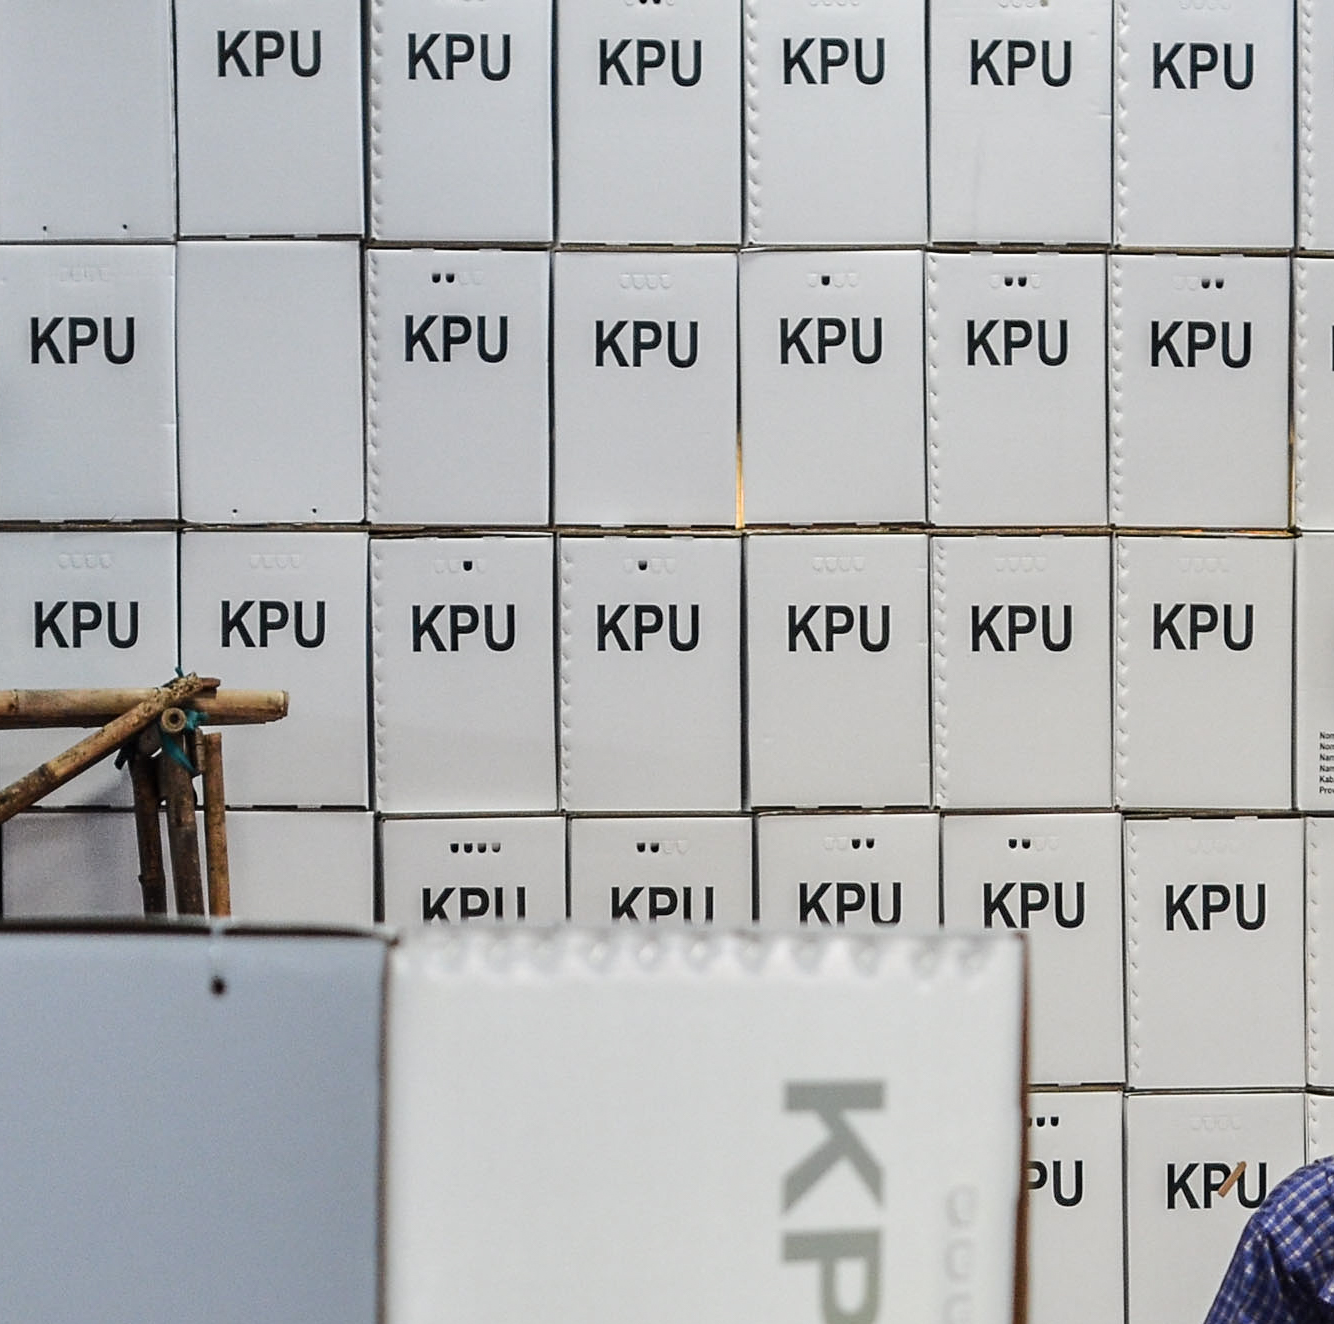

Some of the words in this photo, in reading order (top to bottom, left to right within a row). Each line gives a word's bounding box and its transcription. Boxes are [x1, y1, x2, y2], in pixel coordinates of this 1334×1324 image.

[217, 30, 322, 78] KPU
[407, 32, 511, 82] KPU
[599, 38, 702, 88] KPU
[783, 37, 885, 86] KPU
[970, 39, 1072, 88] KPU
[1153, 42, 1254, 91] KPU
[30, 316, 135, 365] KPU
[405, 314, 508, 364] KPU
[595, 320, 699, 369] KPU
[780, 317, 883, 365] KPU
[966, 319, 1068, 367] KPU
[1150, 320, 1252, 369] KPU
[34, 600, 139, 649] KPU
[221, 600, 326, 649] KPU
[412, 604, 516, 653] KPU
[597, 604, 700, 652] KPU
[788, 604, 890, 653] KPU
[971, 604, 1072, 652] KPU
[1153, 603, 1254, 652] KPU
[799, 883, 902, 926] KPU
[983, 881, 1085, 929] KPU
[1165, 883, 1266, 932] KPU
[1027, 1160, 1083, 1207] PU
[1167, 1162, 1267, 1209] KPU
